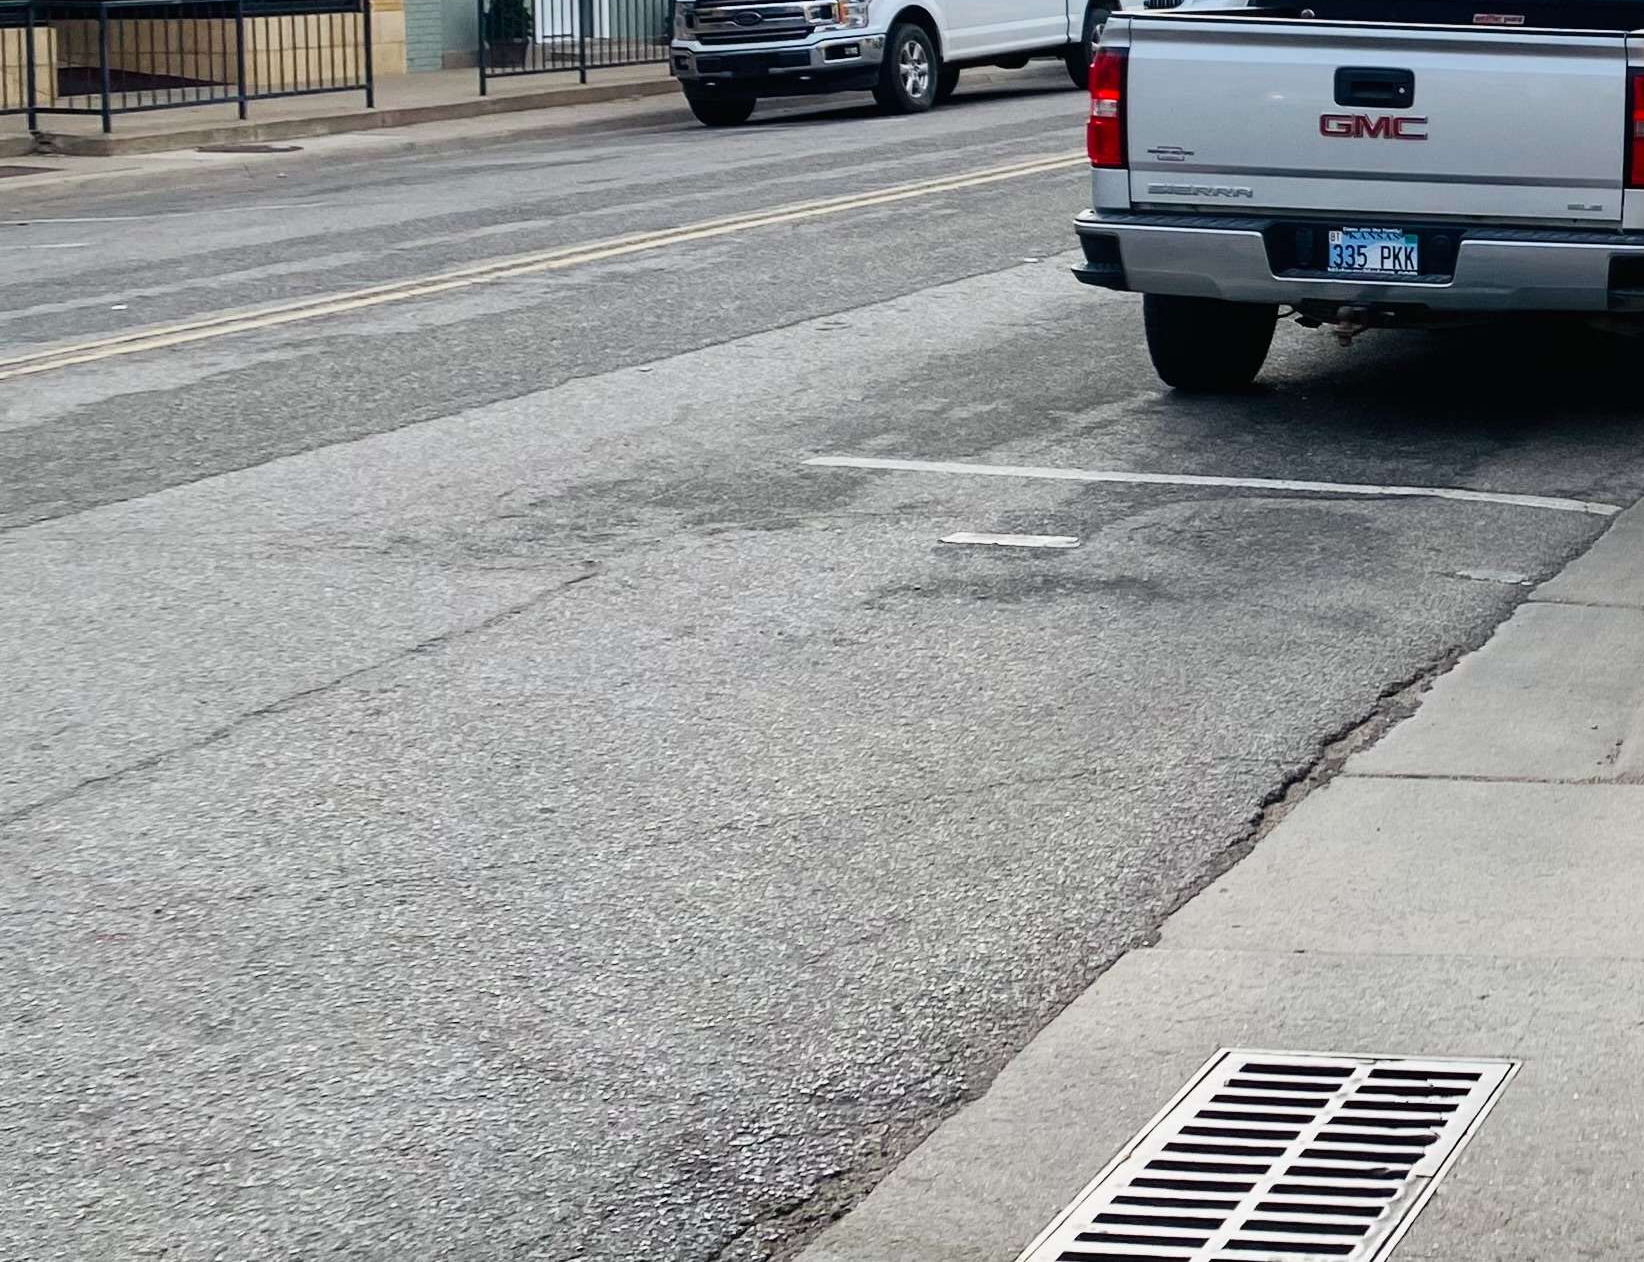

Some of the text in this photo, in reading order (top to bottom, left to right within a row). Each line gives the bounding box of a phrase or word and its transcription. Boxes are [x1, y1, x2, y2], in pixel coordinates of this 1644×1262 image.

[1319, 114, 1429, 140] GMC
[1148, 184, 1254, 199] SIERRA
[1333, 244, 1415, 270] 335 PKK
